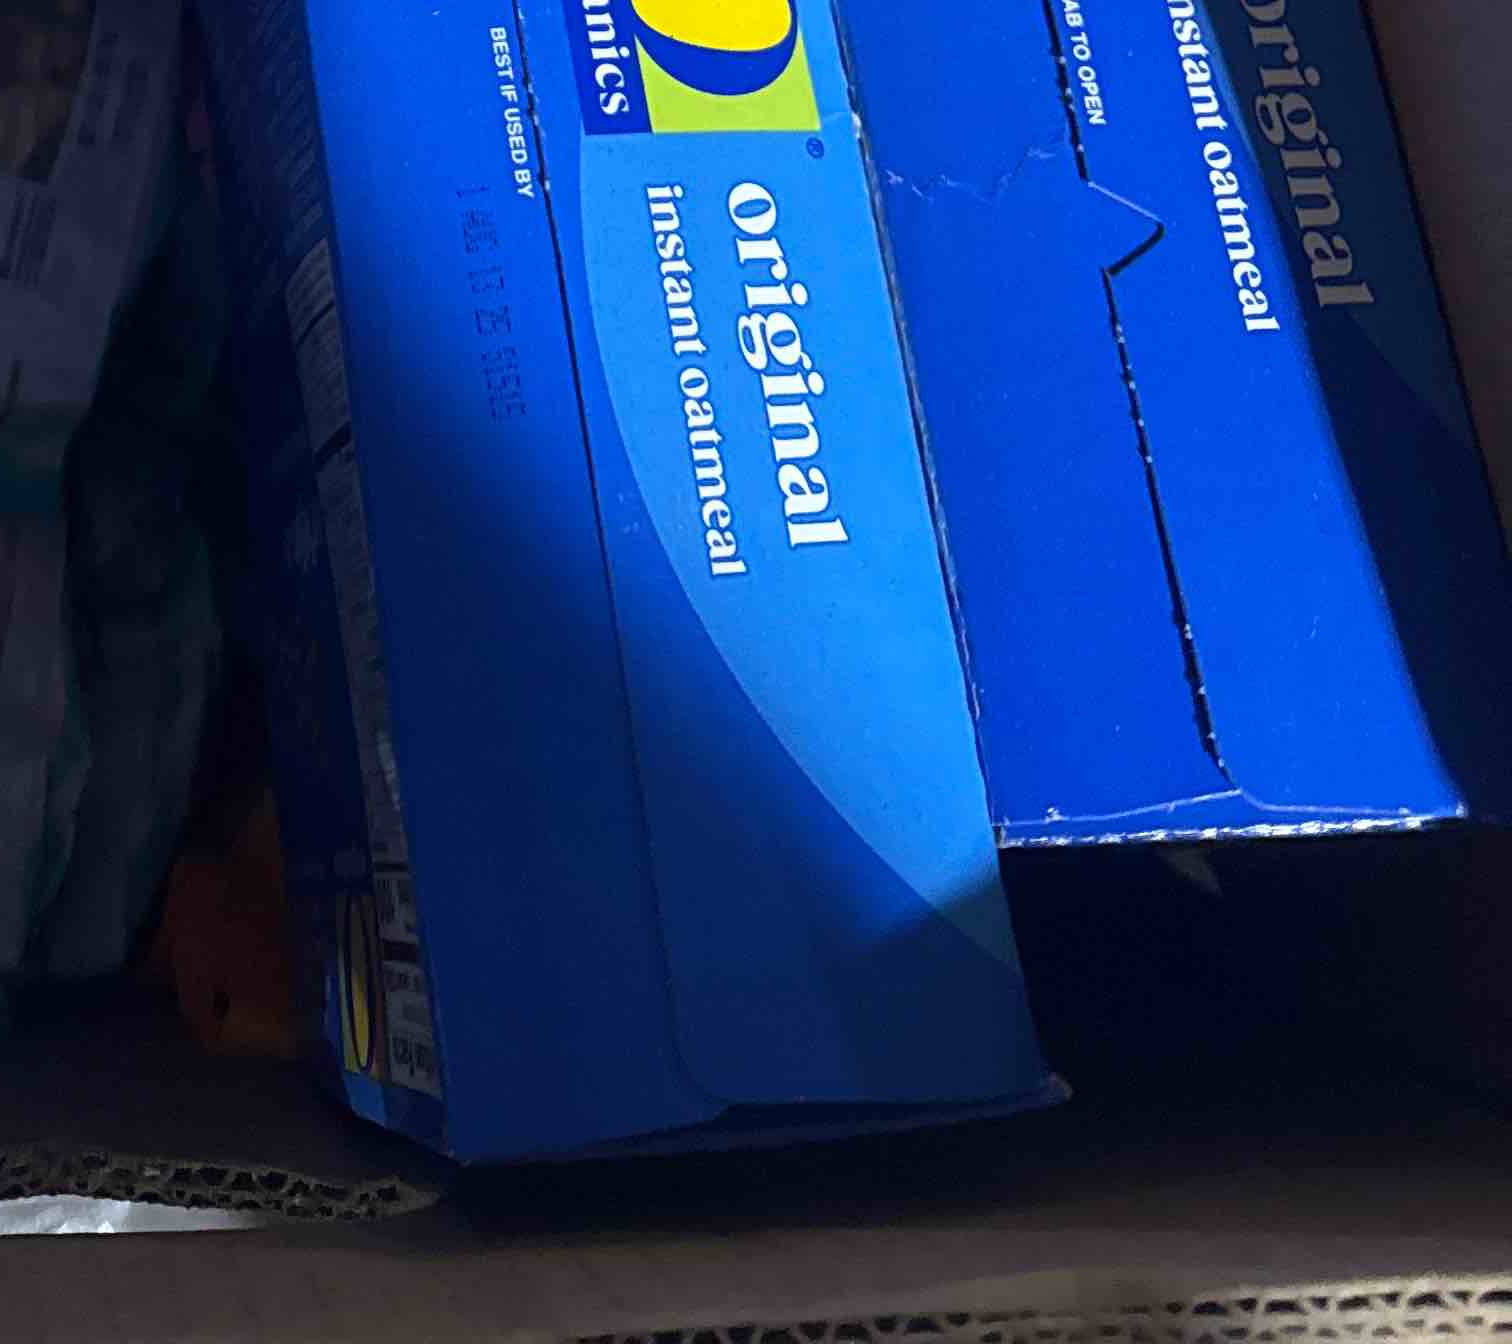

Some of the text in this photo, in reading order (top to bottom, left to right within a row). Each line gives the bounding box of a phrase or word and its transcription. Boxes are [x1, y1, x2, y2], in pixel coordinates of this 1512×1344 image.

[489, 25, 534, 199] BEST IF USED BY
[1067, 31, 1088, 58] TO
[1073, 60, 1106, 126] OPEN
[1202, 140, 1280, 333] oatmeal
[646, 184, 748, 577] instant oatmeal
[727, 180, 848, 550] original
